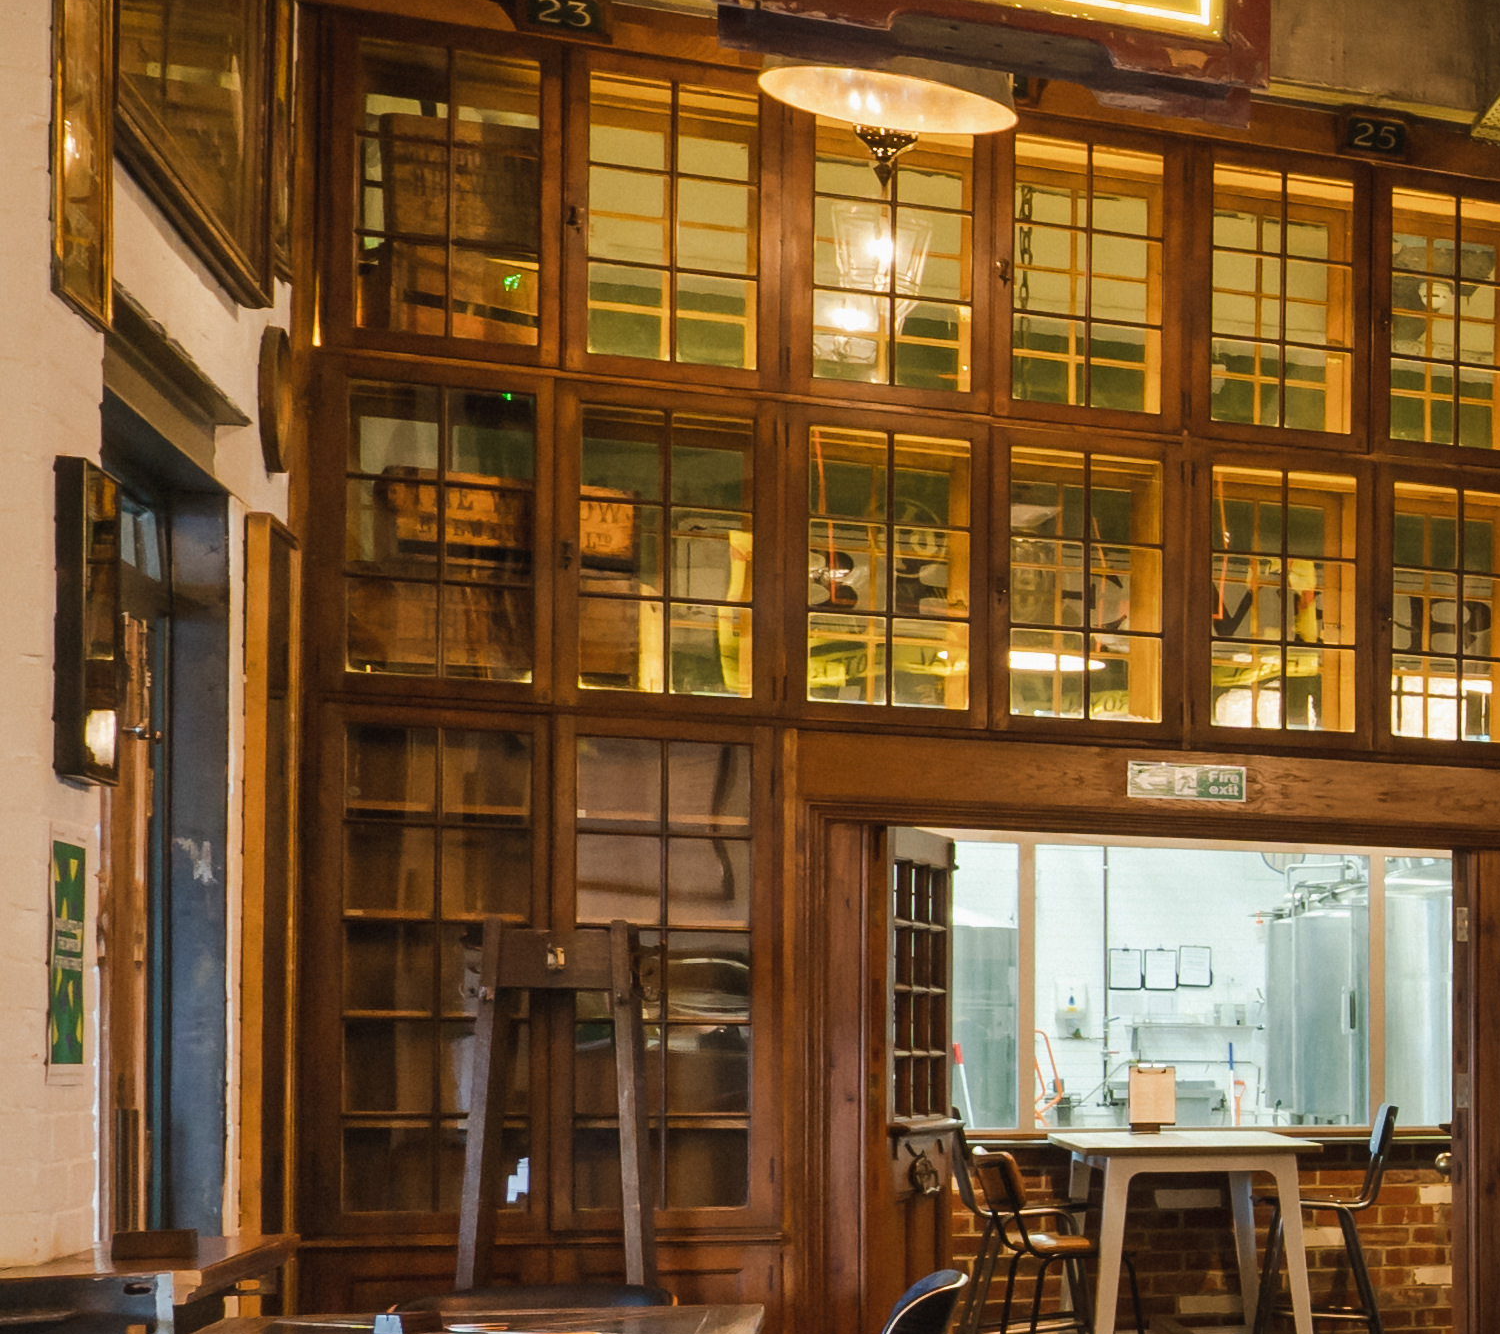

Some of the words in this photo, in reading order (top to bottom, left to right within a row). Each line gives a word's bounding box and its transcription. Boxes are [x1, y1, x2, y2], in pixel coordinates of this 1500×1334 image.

[1353, 122, 1396, 149] 25
[1208, 770, 1240, 784] Fire
[1208, 783, 1240, 798] exit
